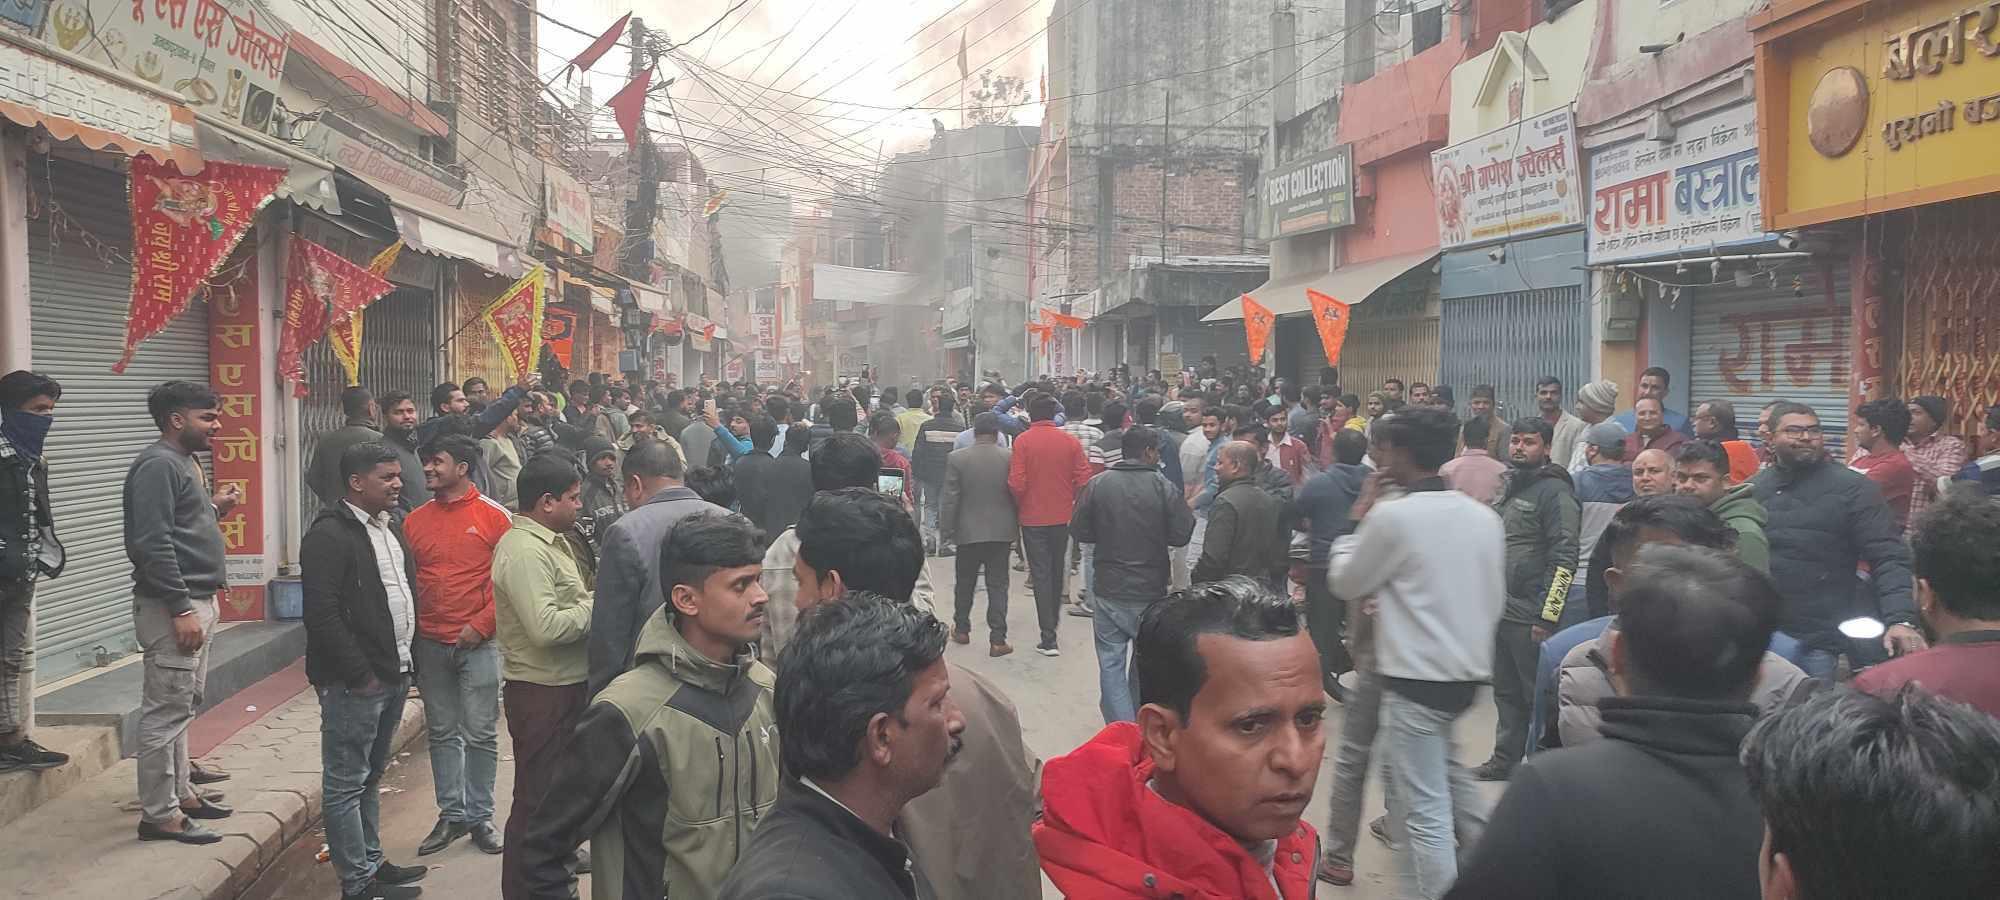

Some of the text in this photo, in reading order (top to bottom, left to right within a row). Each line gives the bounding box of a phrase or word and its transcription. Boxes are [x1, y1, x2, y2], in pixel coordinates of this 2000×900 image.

[1269, 155, 1346, 206] BEST COLLECTION
[1459, 164, 1476, 198] श्री
[1477, 157, 1515, 190] गणेश
[1515, 135, 1567, 181] ज्वेलर्स
[1594, 168, 1671, 235] रामा
[151, 222, 180, 304] जय श्री राम
